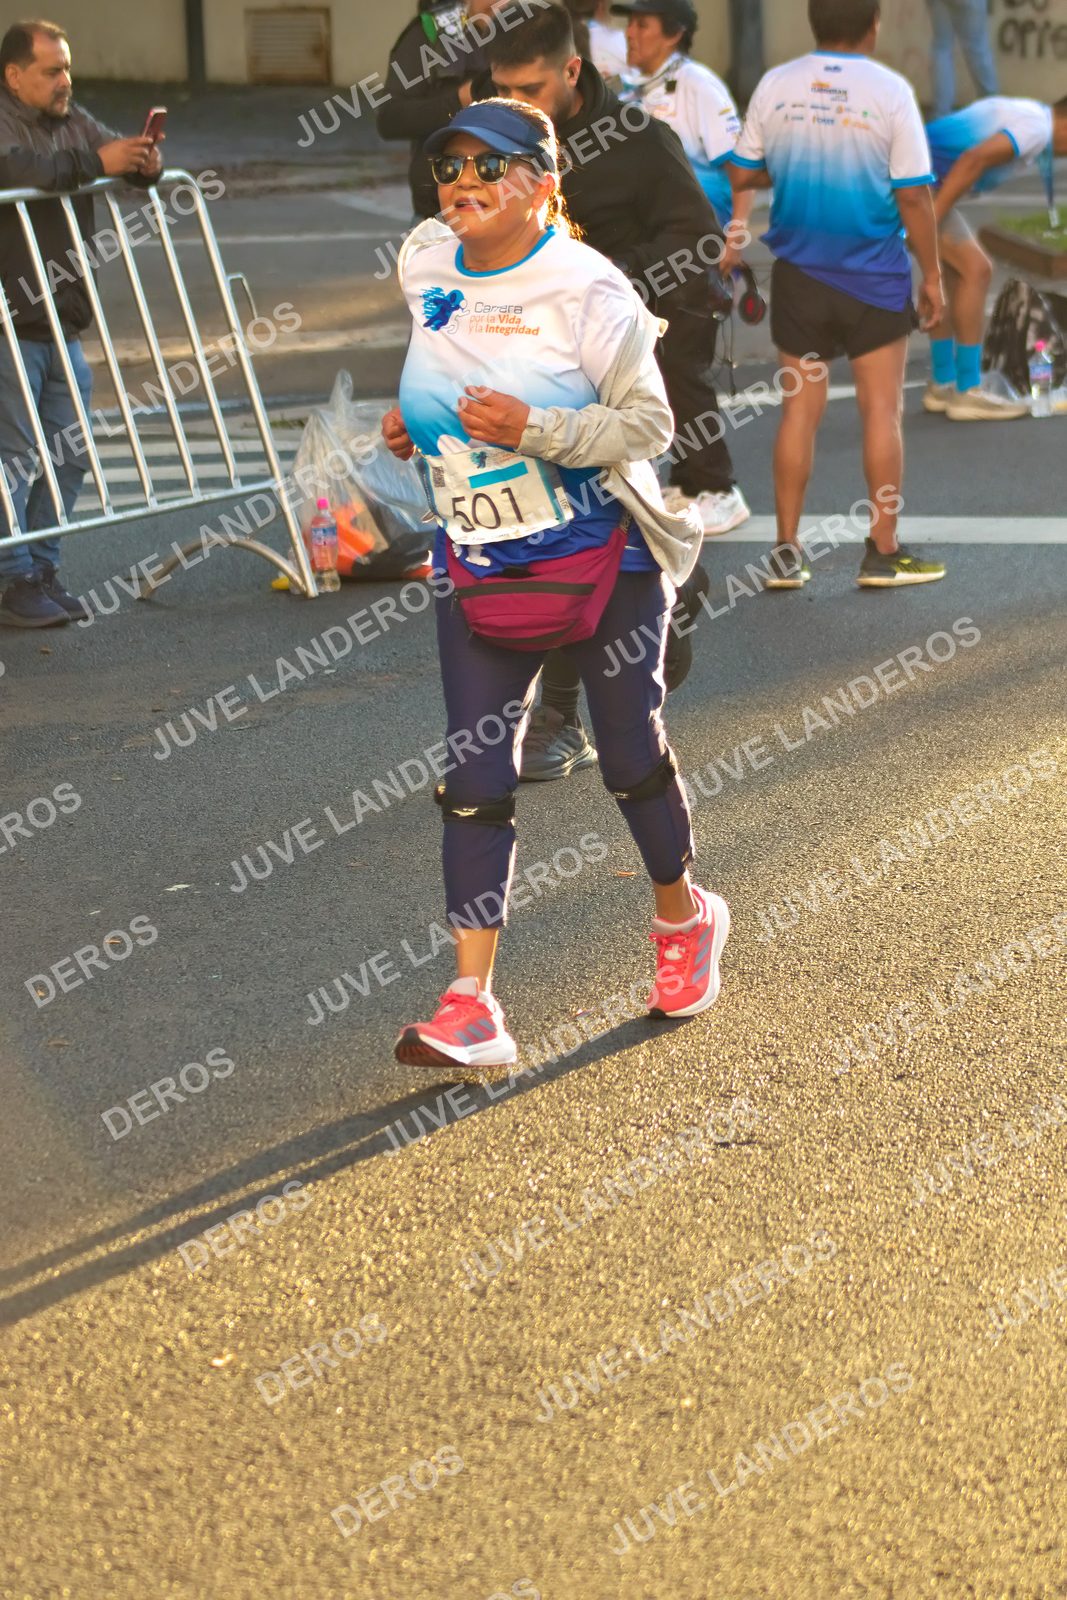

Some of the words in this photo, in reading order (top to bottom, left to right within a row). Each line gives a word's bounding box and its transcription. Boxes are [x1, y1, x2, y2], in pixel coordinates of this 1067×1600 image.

[486, 314, 496, 324] la
[498, 315, 522, 325] Vida
[475, 324, 484, 334] la
[485, 324, 540, 336] Integridad
[452, 487, 525, 533] 501
